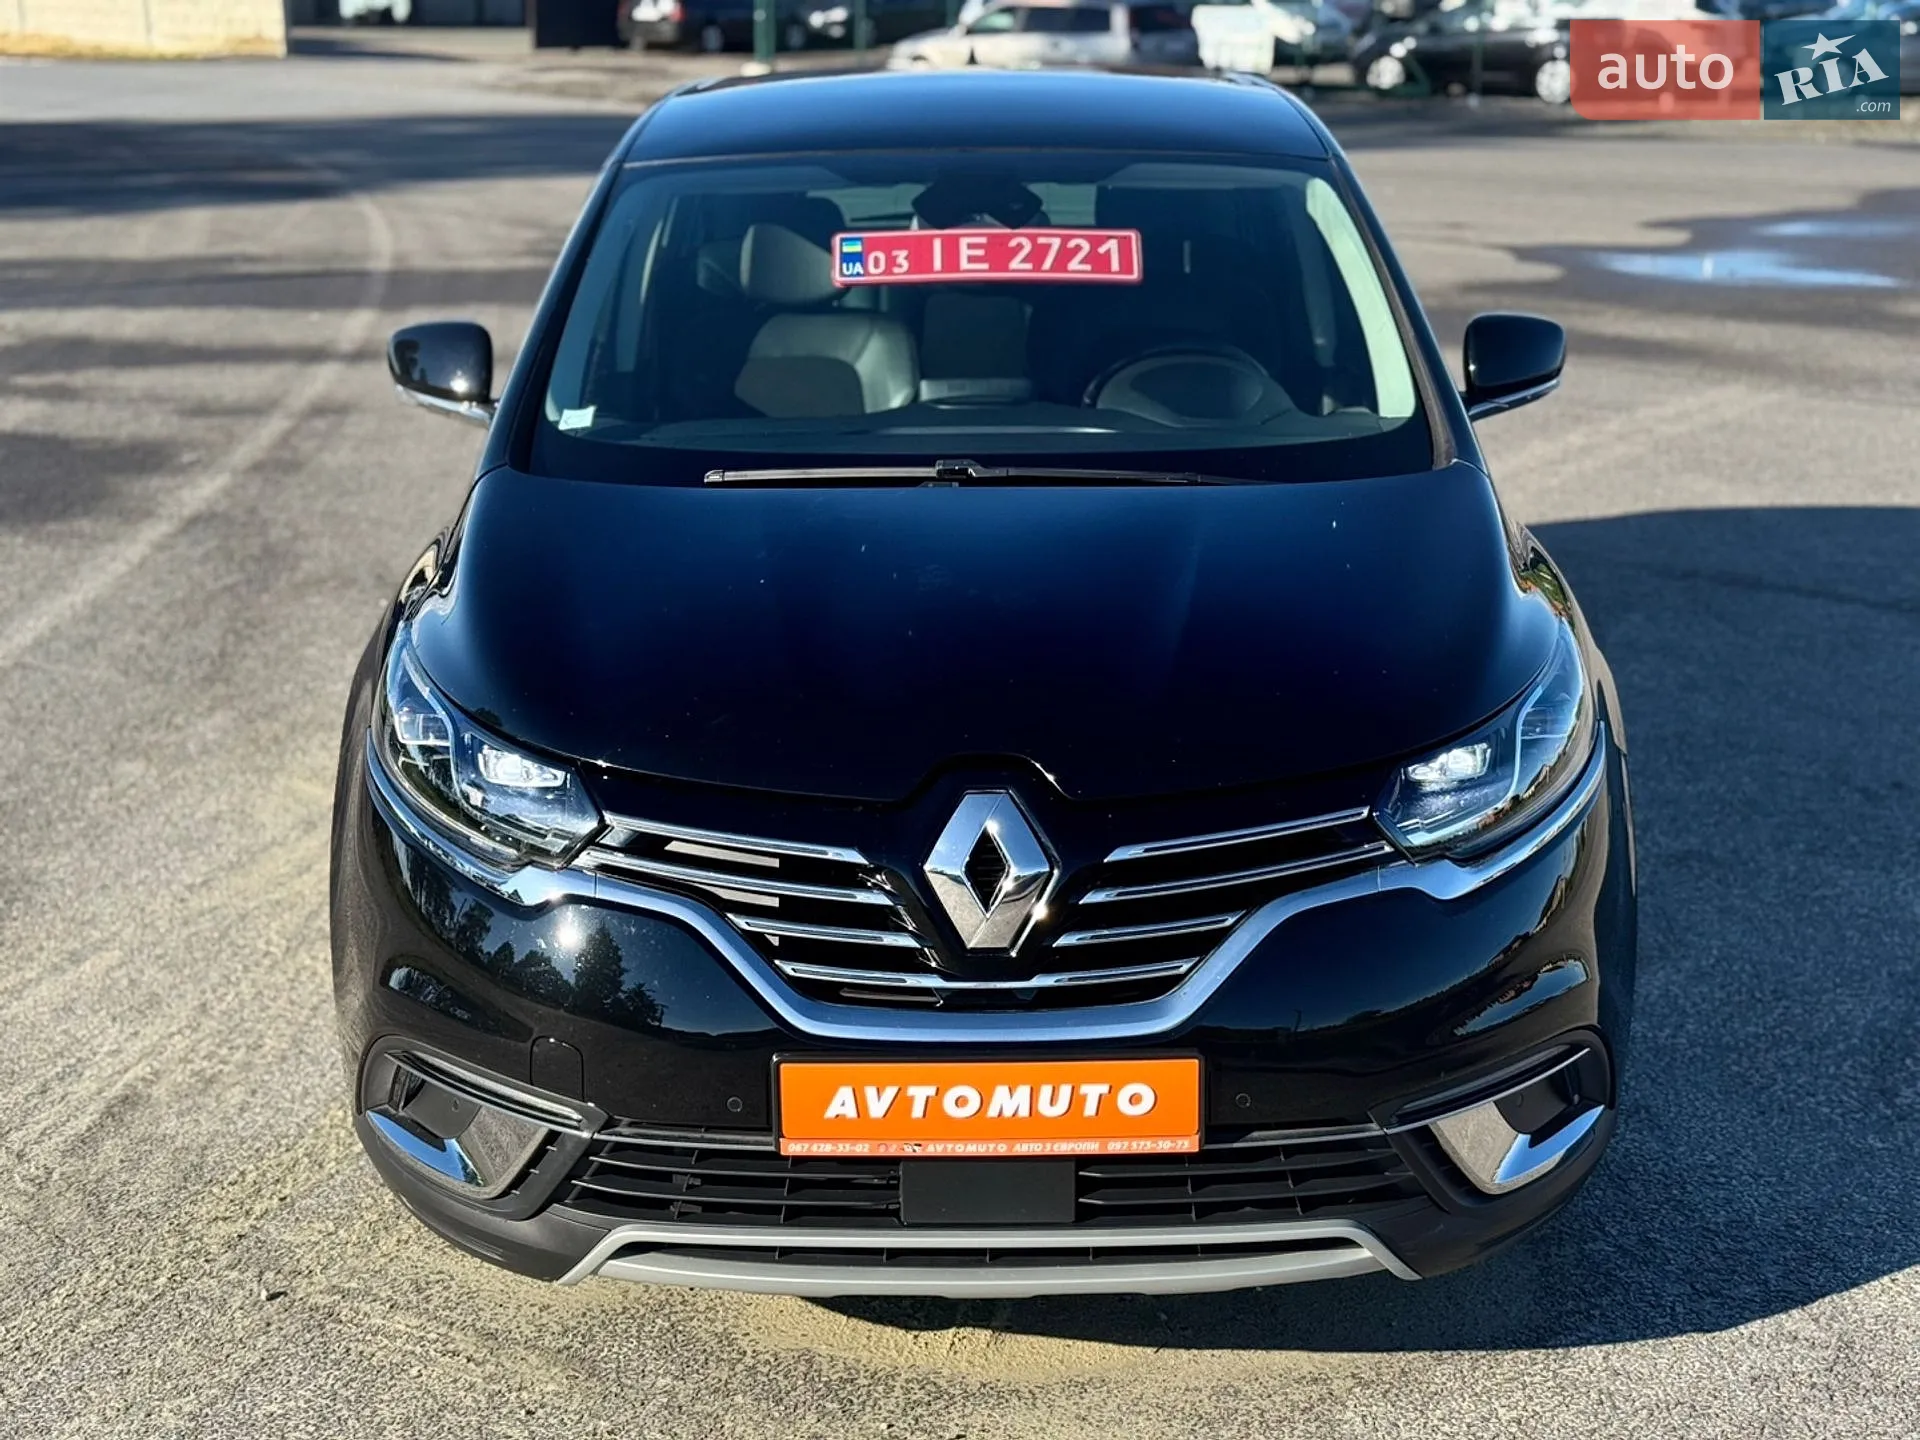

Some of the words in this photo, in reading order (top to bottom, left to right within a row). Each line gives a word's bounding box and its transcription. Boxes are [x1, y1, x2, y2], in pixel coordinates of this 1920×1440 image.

[842, 261, 864, 275] UA
[867, 249, 910, 275] 03
[932, 236, 990, 272] IE
[1007, 236, 1121, 273] 2721
[824, 1082, 1157, 1119] AVTOMUTO
[926, 1143, 1007, 1153] AVTOMUTO
